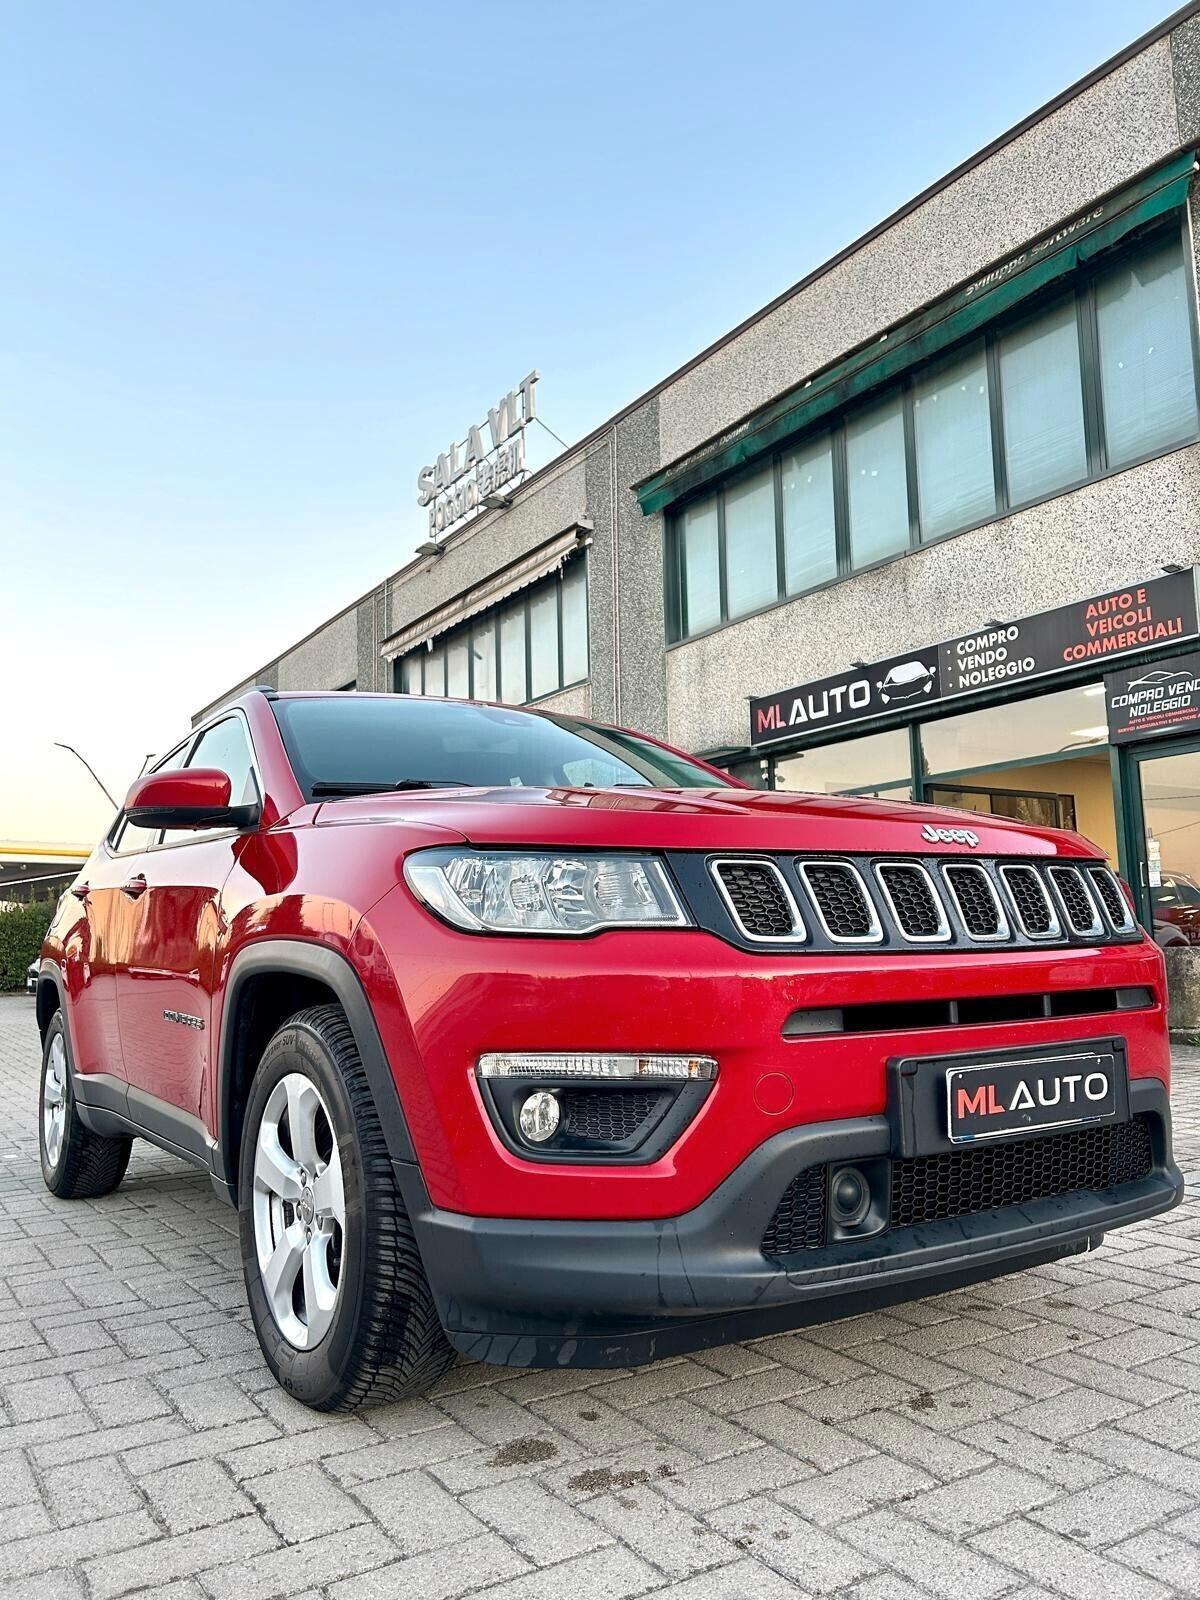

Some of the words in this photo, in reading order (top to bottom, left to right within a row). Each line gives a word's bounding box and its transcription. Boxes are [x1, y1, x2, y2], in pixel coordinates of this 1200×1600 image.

[965, 253, 1027, 297] Sviluppo
[417, 424, 485, 507] SALA
[487, 368, 541, 449] VLT
[1085, 592, 1133, 619] AUTO
[1137, 588, 1146, 604] E
[1086, 607, 1152, 637] VEICOLI
[956, 625, 1019, 656] COMPRO
[1063, 617, 1183, 662] COMMERCIALI
[957, 647, 1008, 672] VENDO
[958, 657, 1035, 689] NOLEGGIO
[788, 679, 871, 726] AUTO
[1111, 687, 1164, 708] COMPRO
[1129, 695, 1191, 717] NOLEGGIO
[921, 824, 980, 848] Jeep
[1009, 1072, 1108, 1111] AUTO
